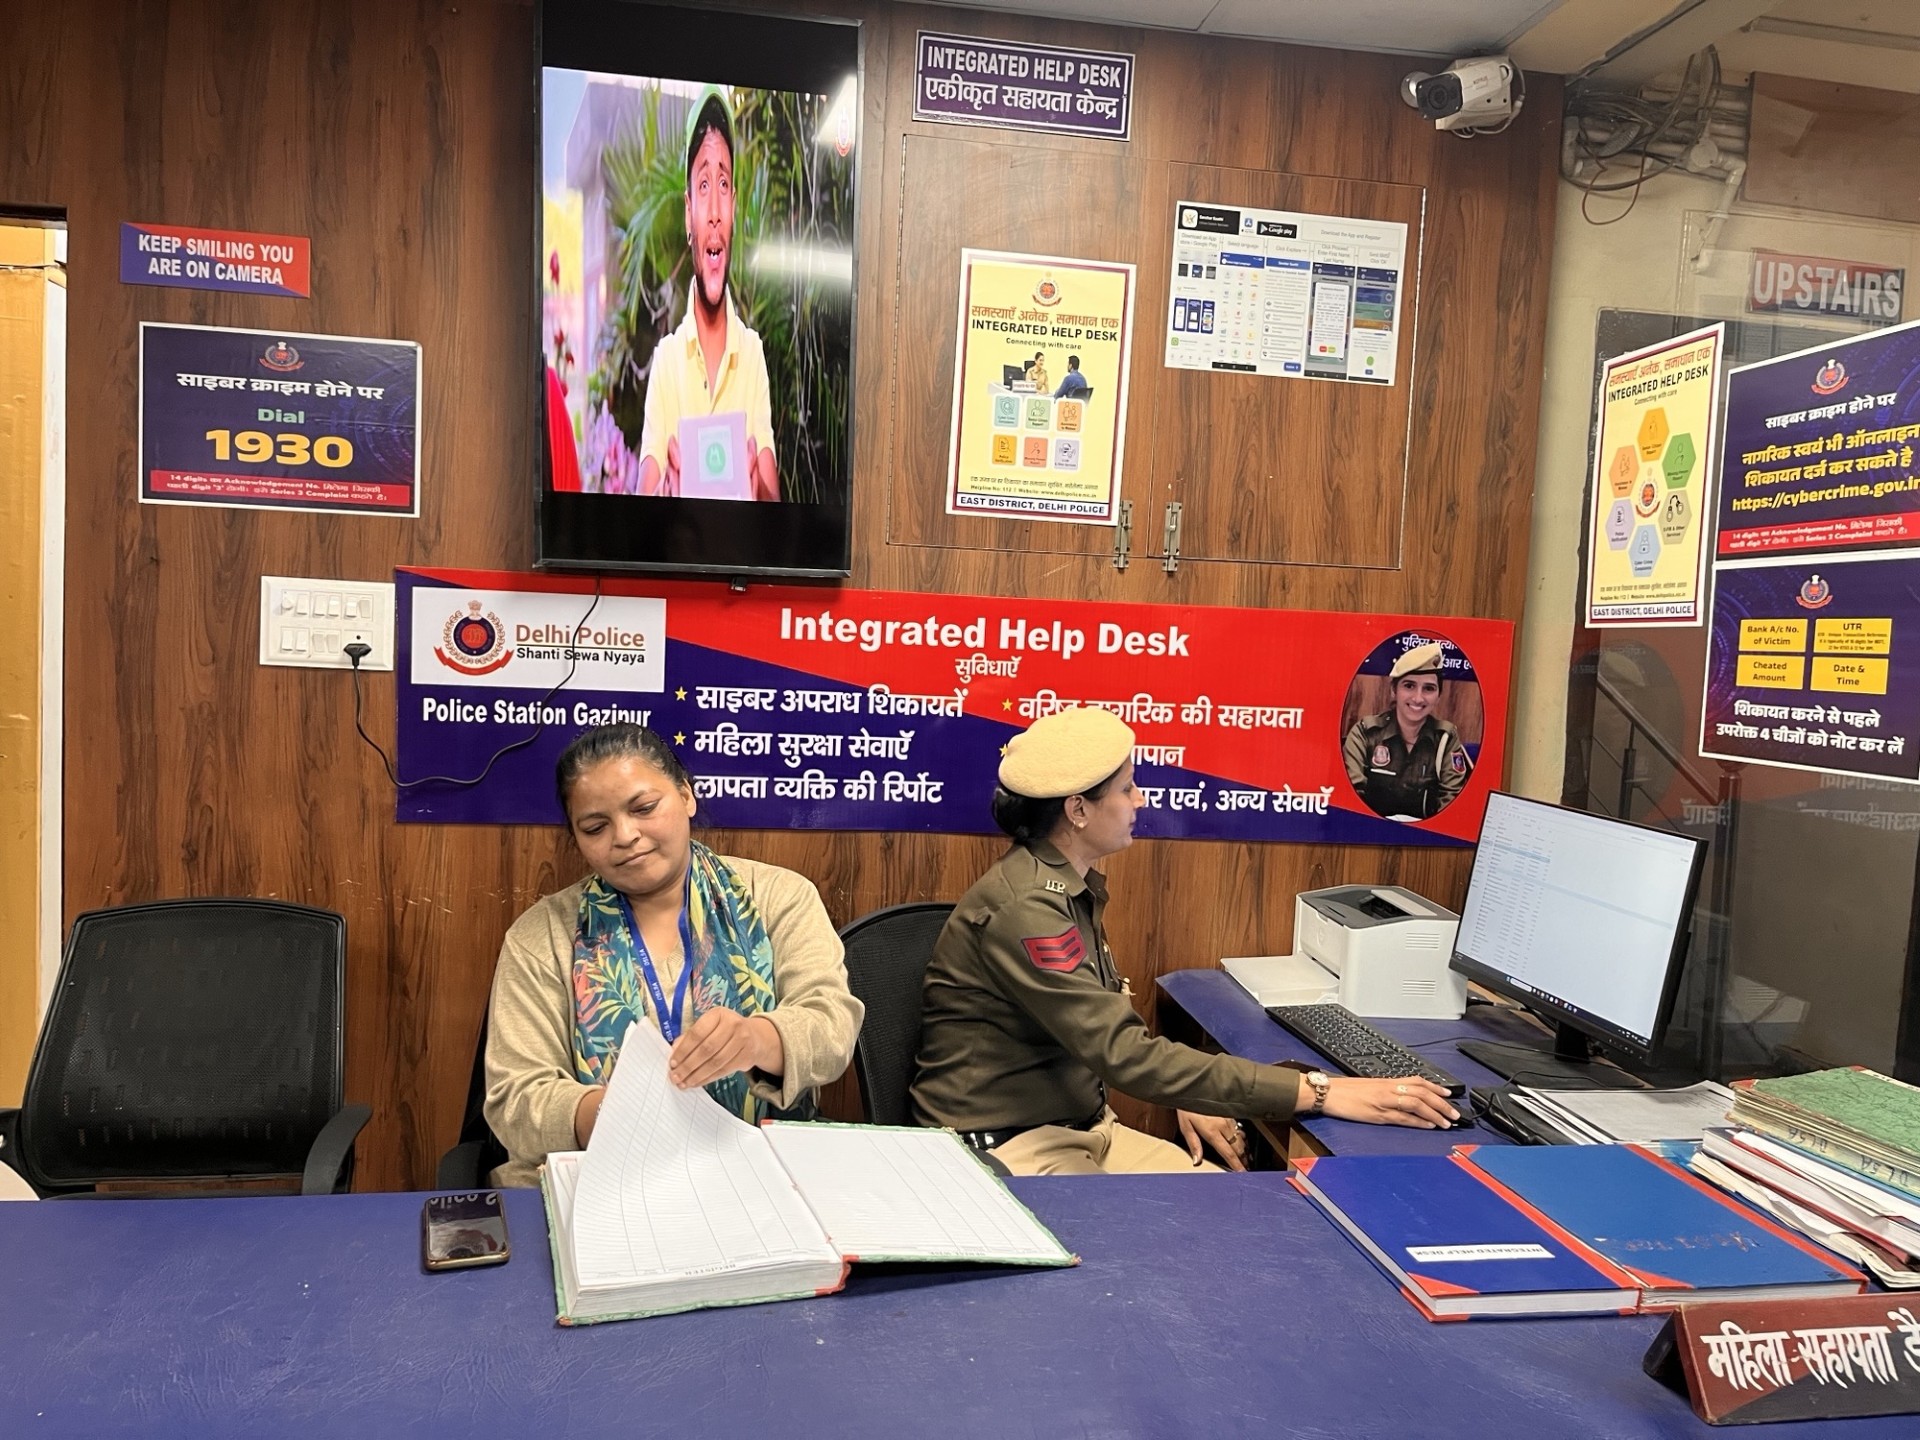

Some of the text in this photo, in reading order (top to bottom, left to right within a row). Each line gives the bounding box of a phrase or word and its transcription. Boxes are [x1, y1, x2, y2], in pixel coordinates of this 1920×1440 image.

[927, 46, 1121, 88] INTEGRATED HELP DESK
[925, 73, 1119, 119] एकीकृत सहायता केन्द्र
[139, 234, 293, 264] KEEP SMILING YOU
[148, 257, 283, 285] ARE ON CAMERA
[1753, 260, 1901, 318] UPSTAIRS
[972, 319, 1118, 342] INTEGRATED HELP DESK
[1056, 313, 1098, 328] समाधान
[1101, 317, 1119, 329] एक
[1006, 337, 1046, 348] Connecting
[1048, 341, 1064, 349] with
[176, 373, 384, 400] साइबर क्राइम होने पर
[1608, 364, 1709, 403] INTEGRATED HELP DESK
[257, 408, 305, 424] Dial
[1765, 392, 1898, 429] साइबर क्राइम होने पर
[205, 429, 353, 468] 1930
[1742, 424, 1920, 466] नागरिक स्वयं भी ऑनलाइन
[183, 475, 208, 484] digits
[224, 478, 303, 489] Acknowledgement
[1745, 466, 1800, 488] शिकायत
[1803, 460, 1826, 480] दर्ज
[1829, 460, 1854, 475] कर
[1856, 450, 1899, 471] सकते
[270, 488, 297, 496] Series
[306, 490, 349, 499] Complaint
[960, 497, 1105, 514] EAST DISTRICT, DELHI POLICE
[1611, 607, 1642, 616] DISTRICT,
[1643, 607, 1664, 615] DELHI
[1666, 605, 1691, 614] POLICE
[515, 624, 645, 647] Delhi Police
[780, 607, 1190, 660] Integrated Help Desk
[1747, 625, 1767, 633] Bank
[1770, 625, 1784, 634] A/c
[1753, 637, 1791, 645] of Victim
[1843, 623, 1862, 631] UTR
[516, 647, 645, 665] Shanti Sewa Nyaya
[1753, 661, 1787, 670] Cheated
[1833, 664, 1865, 673] Date &
[1752, 673, 1786, 682] Amount
[1836, 677, 1860, 686] Time
[423, 698, 487, 724] Police
[493, 700, 566, 726] Station
[695, 684, 969, 717] साइबर अपराध शिकायतें
[1181, 695, 1212, 725] की
[1217, 704, 1304, 729] सहायता
[1734, 700, 1881, 728] शिकायत करने से पहले
[694, 722, 772, 756] महिला
[778, 732, 843, 768] सुरक्षा
[1716, 722, 1905, 755] उपरोक्त 4 चीजों को नोट कर लें
[693, 774, 768, 799] लापता
[774, 769, 838, 800] व्यक्ति
[843, 770, 878, 800] की
[1169, 781, 1207, 812] एवं,
[1215, 788, 1265, 812] अन्य
